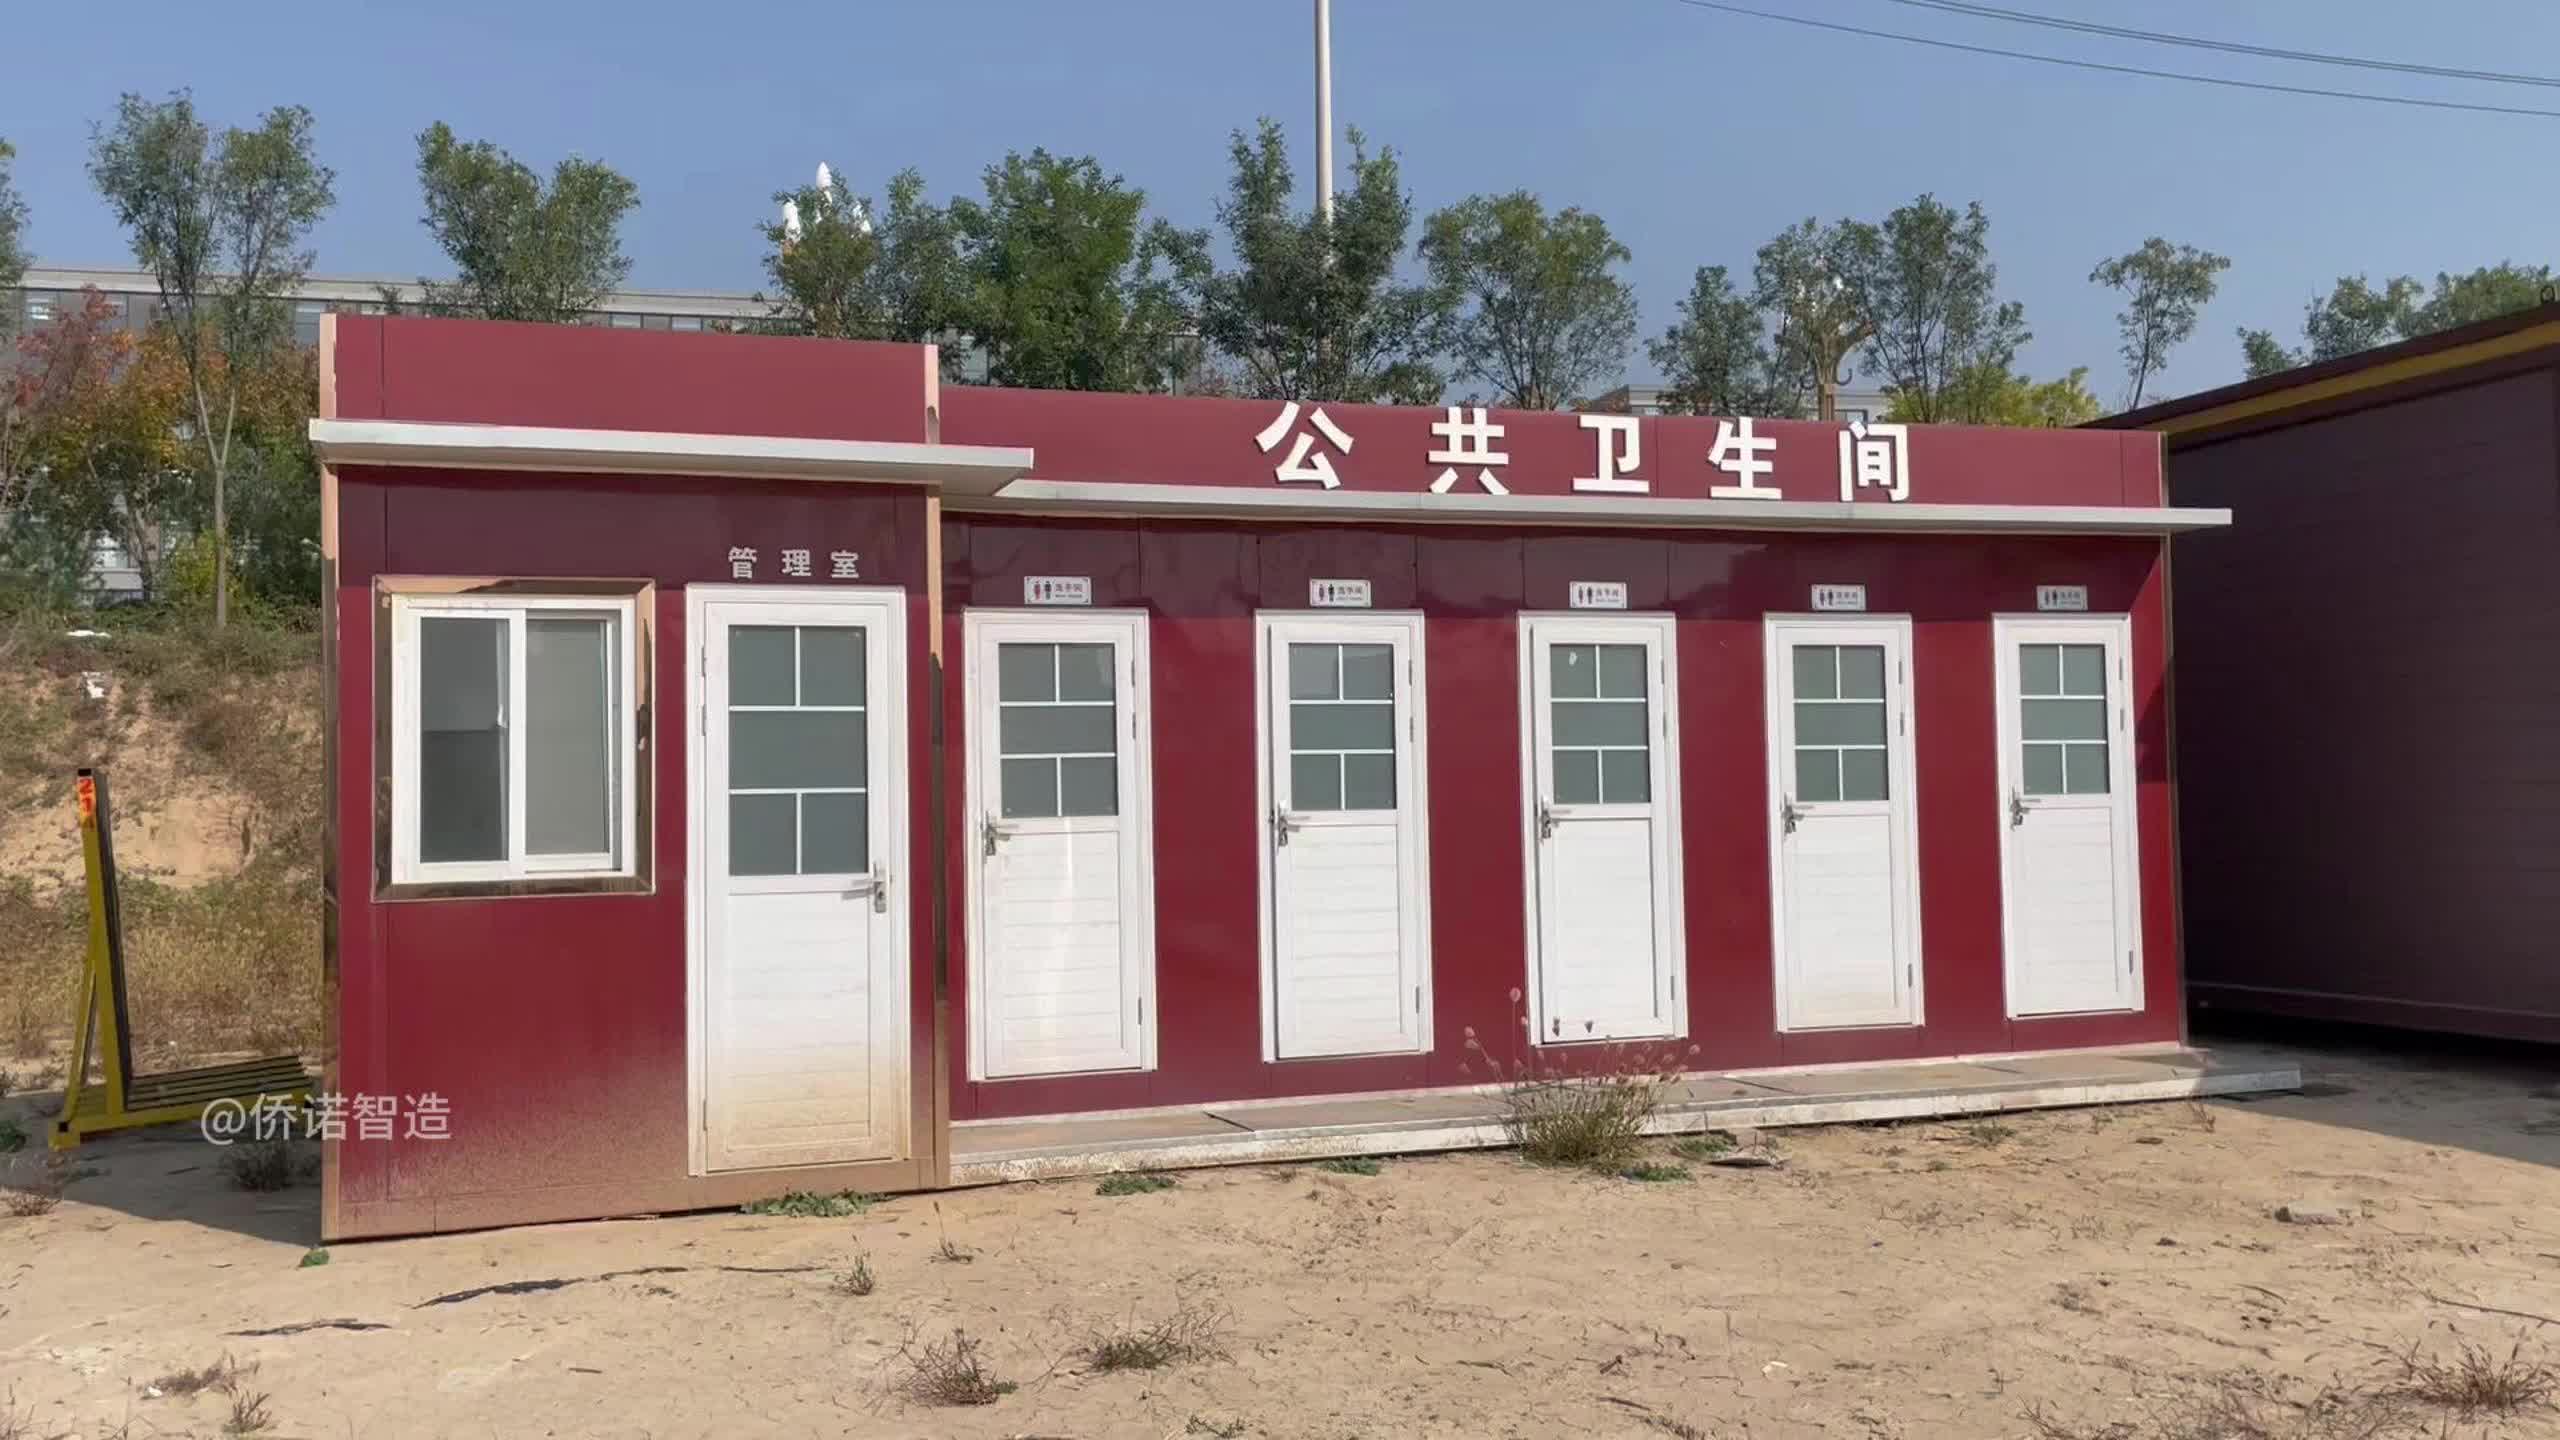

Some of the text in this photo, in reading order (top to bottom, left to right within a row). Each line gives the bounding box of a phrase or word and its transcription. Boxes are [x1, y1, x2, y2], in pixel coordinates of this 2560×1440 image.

[1254, 401, 1910, 502] 公共卫生间
[728, 546, 860, 579] 管理室
